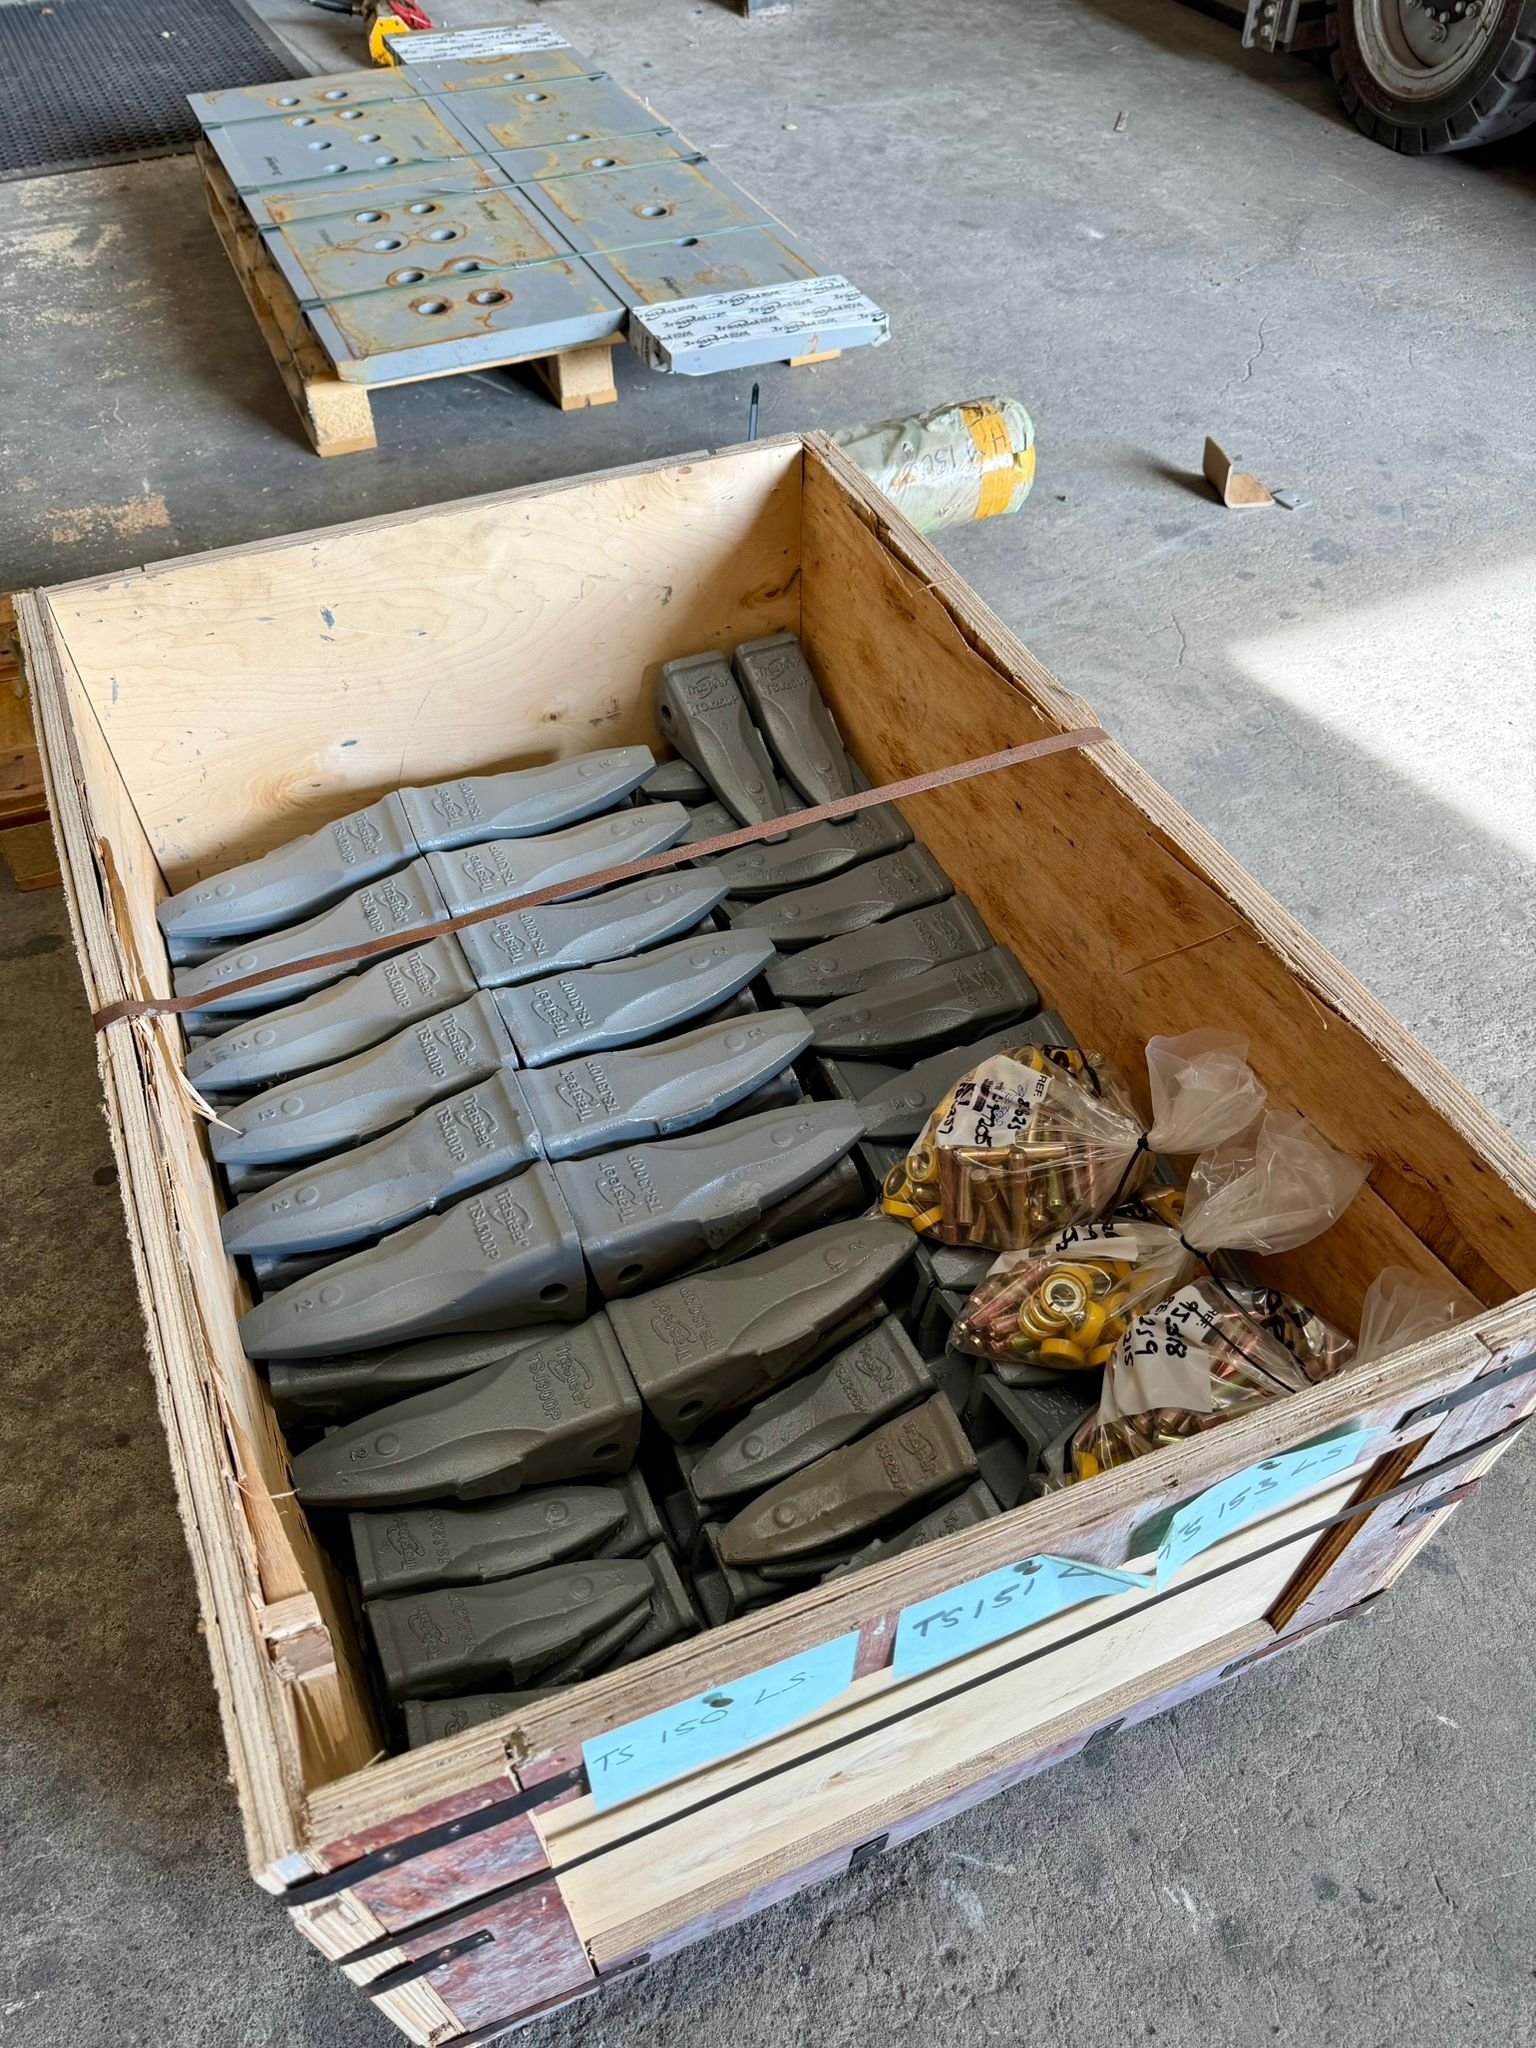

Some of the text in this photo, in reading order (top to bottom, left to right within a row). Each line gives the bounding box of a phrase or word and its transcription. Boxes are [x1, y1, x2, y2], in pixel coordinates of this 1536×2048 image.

[355, 812, 381, 855] Trasteel
[465, 851, 494, 894] Trasteel
[381, 879, 410, 924] Trasteel
[494, 920, 525, 965] Trasteel
[408, 951, 437, 998] Trasteel
[440, 1013, 473, 1067] Trasteel
[532, 987, 569, 1038] Trasteel
[416, 1023, 447, 1079] TSJ300P
[558, 1068, 594, 1124] Trasteel
[1033, 1074, 1048, 1098] REF.
[436, 1104, 468, 1163] TSJ300P
[462, 1093, 496, 1150] Trasteel
[496, 1188, 531, 1248] Trasteel
[599, 1162, 636, 1224] Trasteel
[467, 1199, 501, 1260] TSJ300P
[653, 1300, 693, 1364] Trasteel
[527, 1351, 562, 1421] TSJ300P
[556, 1340, 592, 1409] Trasteel
[1218, 1477, 1279, 1519] 153
[592, 1743, 635, 1773] TS
[661, 1708, 730, 1744] 150
